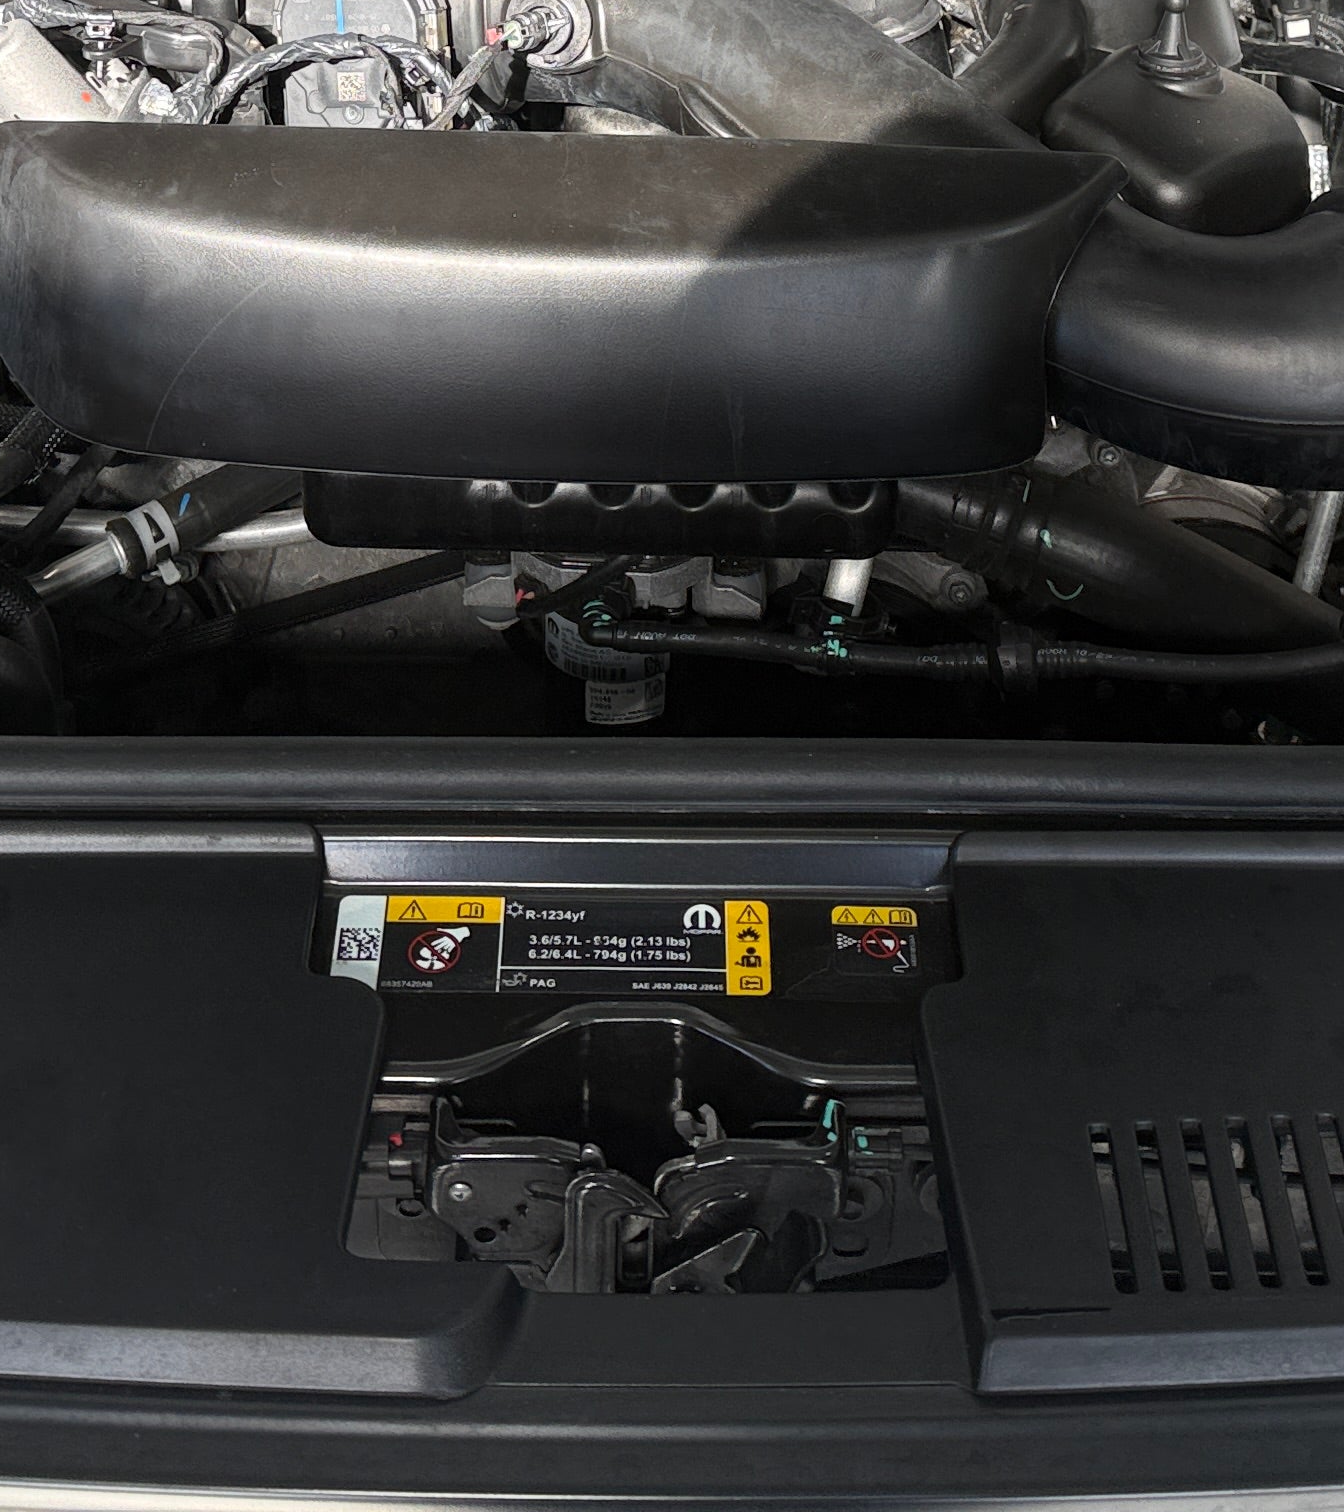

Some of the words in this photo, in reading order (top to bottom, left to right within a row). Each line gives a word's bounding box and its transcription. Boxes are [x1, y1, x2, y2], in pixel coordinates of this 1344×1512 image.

[525, 909, 586, 923] R-1234yf
[529, 935, 583, 946] 3.6/5.7L
[631, 936, 663, 949] (2.13
[666, 936, 692, 950] lbs)
[528, 949, 583, 960] 6.2/6.4L
[593, 949, 627, 962] 794g
[631, 950, 663, 963] (1.75
[666, 950, 692, 963] lbs)
[529, 978, 556, 988] PAG
